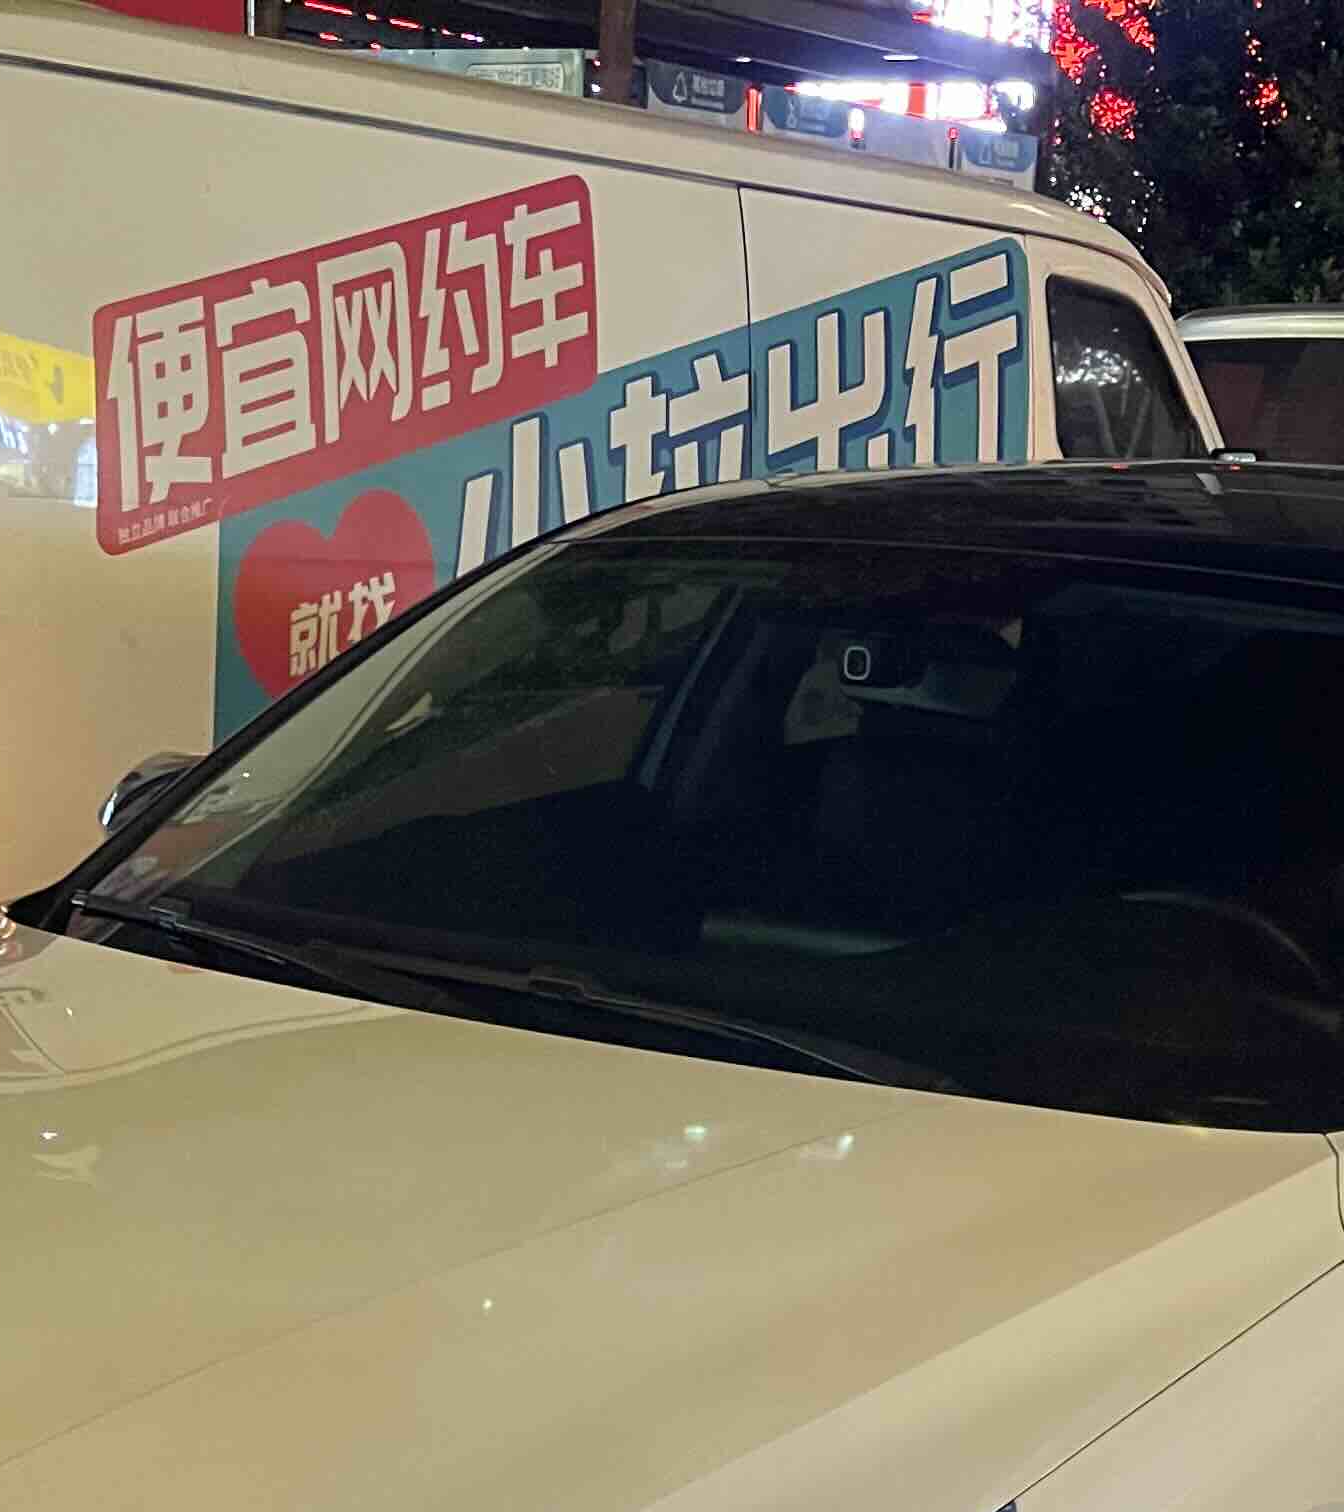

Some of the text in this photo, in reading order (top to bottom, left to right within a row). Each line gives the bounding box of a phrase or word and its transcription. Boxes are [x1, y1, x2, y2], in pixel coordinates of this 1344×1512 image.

[107, 201, 589, 513] 便宜网约车
[290, 571, 396, 676] 就找
